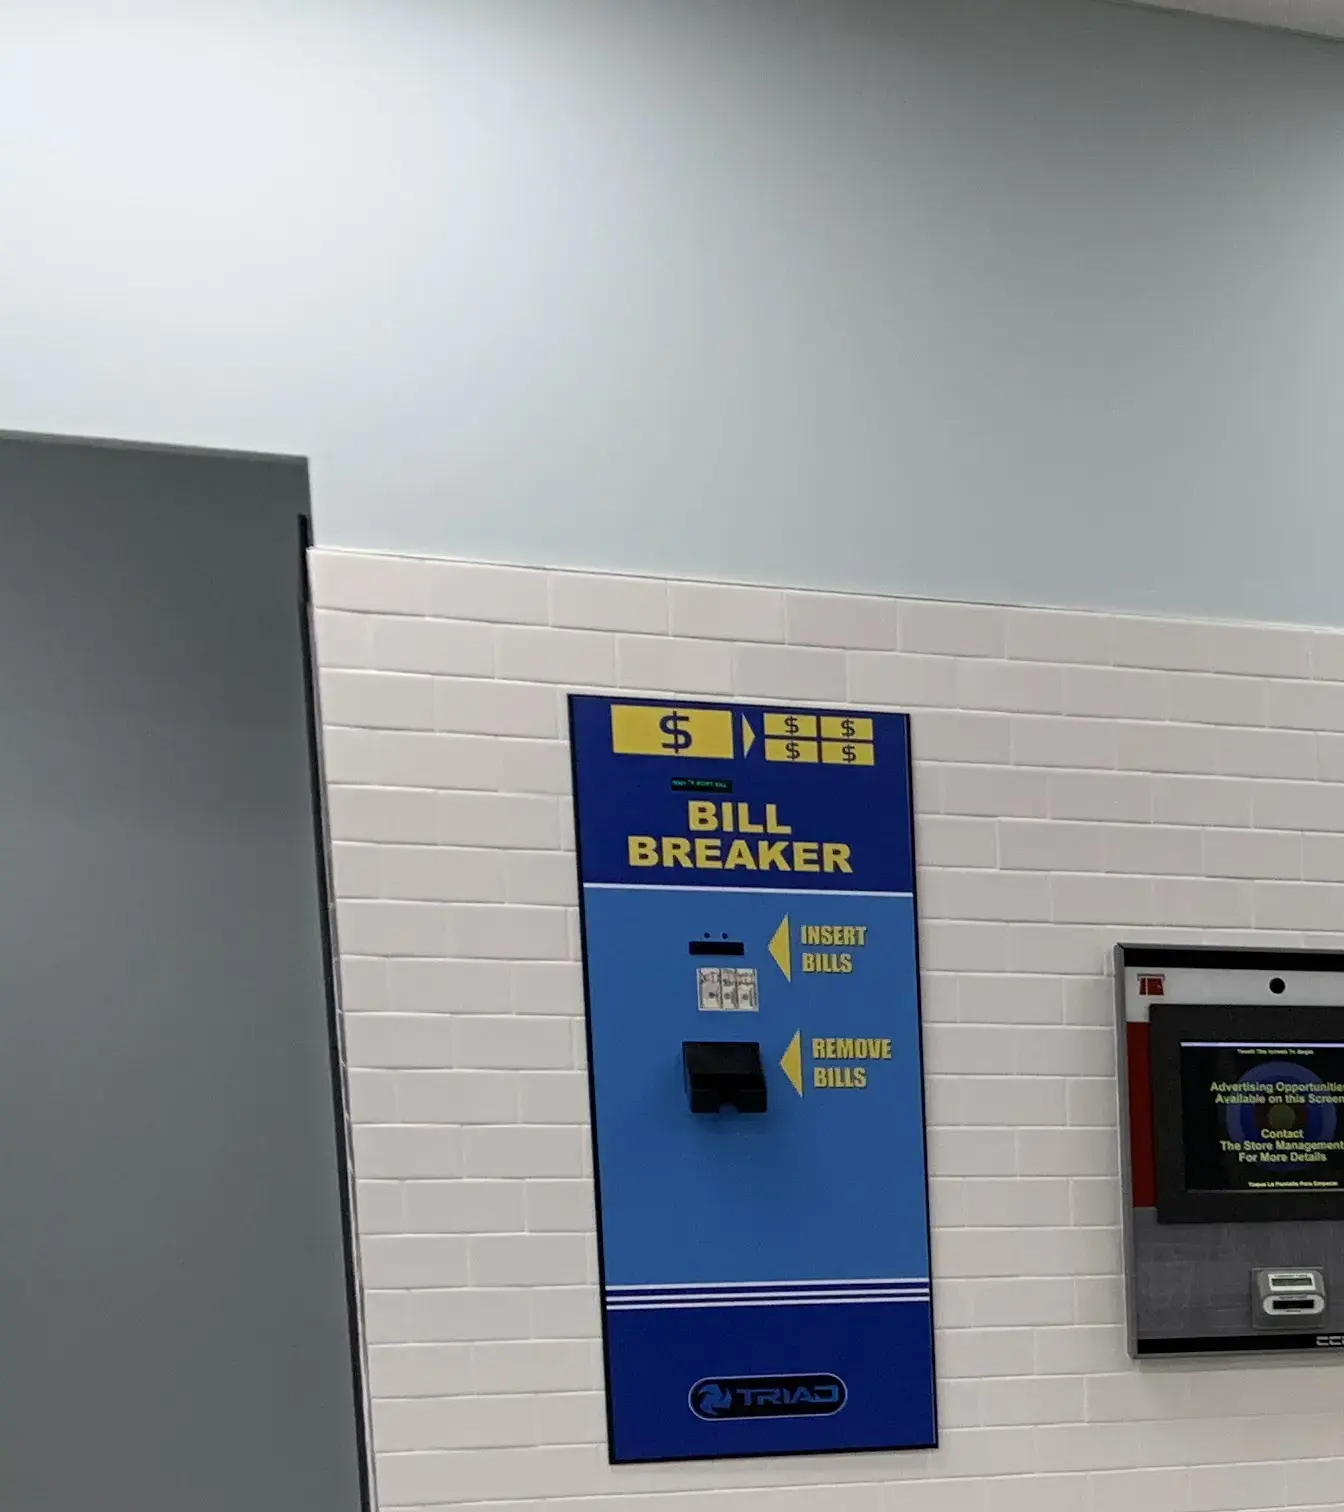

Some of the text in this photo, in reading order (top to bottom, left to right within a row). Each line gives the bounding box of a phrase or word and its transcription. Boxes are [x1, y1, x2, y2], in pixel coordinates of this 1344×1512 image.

[688, 800, 792, 835] BILL
[627, 835, 854, 874] BREAKER
[801, 924, 867, 947] INSERT
[802, 952, 853, 974] BILLS
[811, 1037, 892, 1060] REMOVE
[814, 1066, 867, 1089] BILLS
[1210, 1081, 1274, 1093] Advertising
[1215, 1093, 1266, 1104] Available
[1268, 1095, 1282, 1104] on
[1285, 1093, 1305, 1104] this
[1261, 1128, 1304, 1139] Contact
[1220, 1140, 1344, 1152] The Store Management
[1239, 1151, 1327, 1162] For More Details
[735, 1385, 839, 1407] TRIAD
